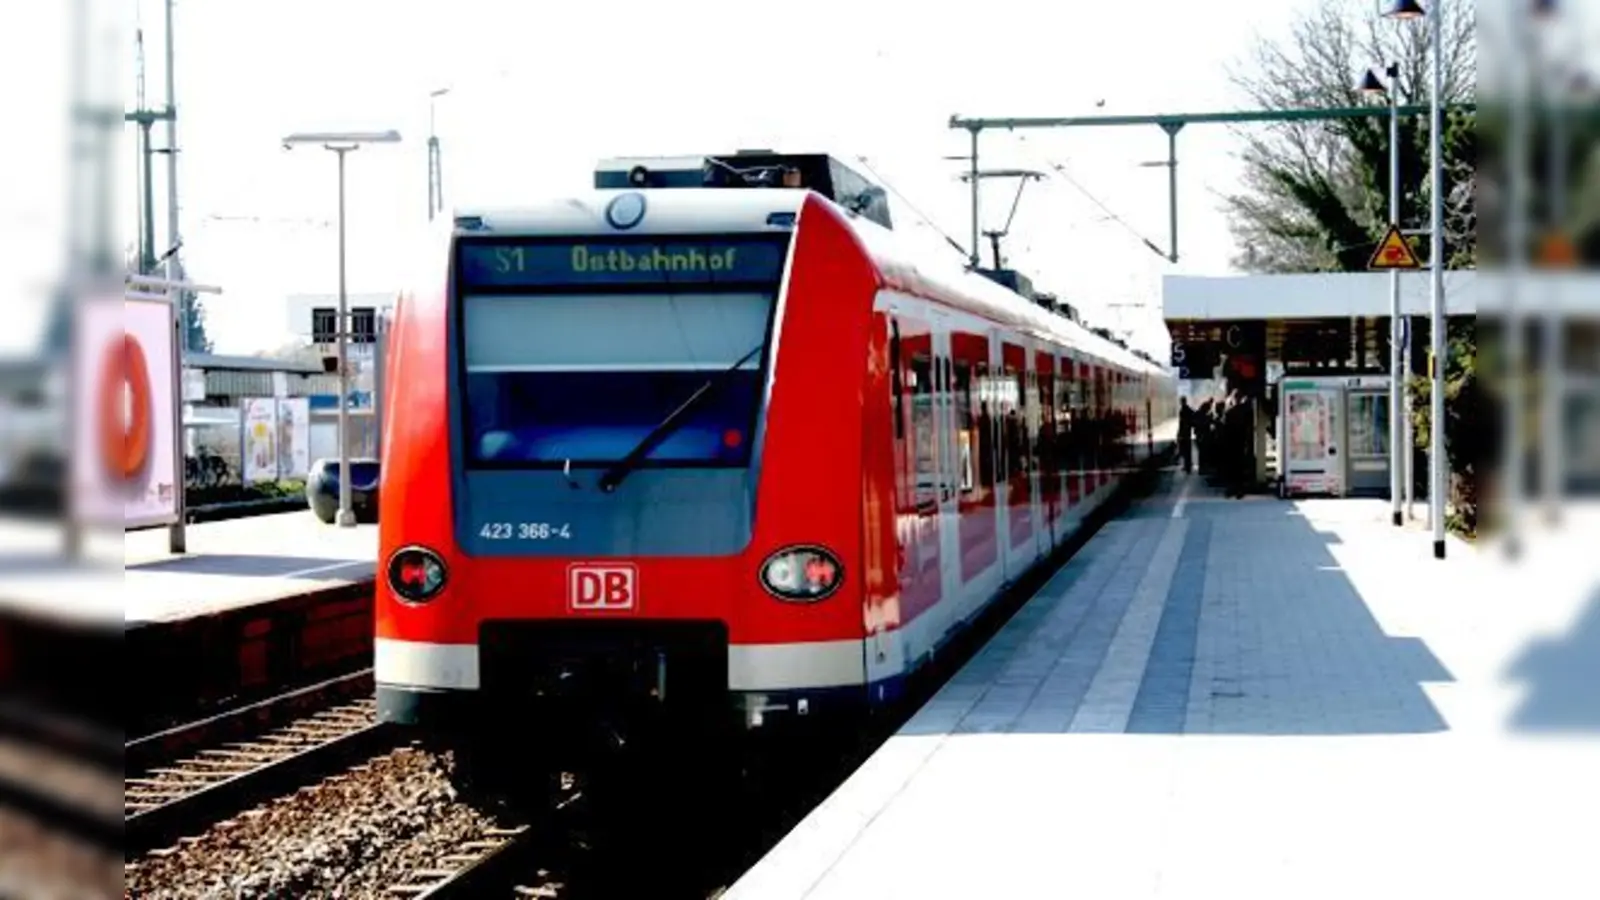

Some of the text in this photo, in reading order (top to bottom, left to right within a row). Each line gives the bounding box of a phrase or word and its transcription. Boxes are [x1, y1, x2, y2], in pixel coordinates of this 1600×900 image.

[495, 245, 733, 273] S1 Ostbahnhof
[479, 523, 571, 539] 423 366-4
[576, 572, 630, 604] DB
